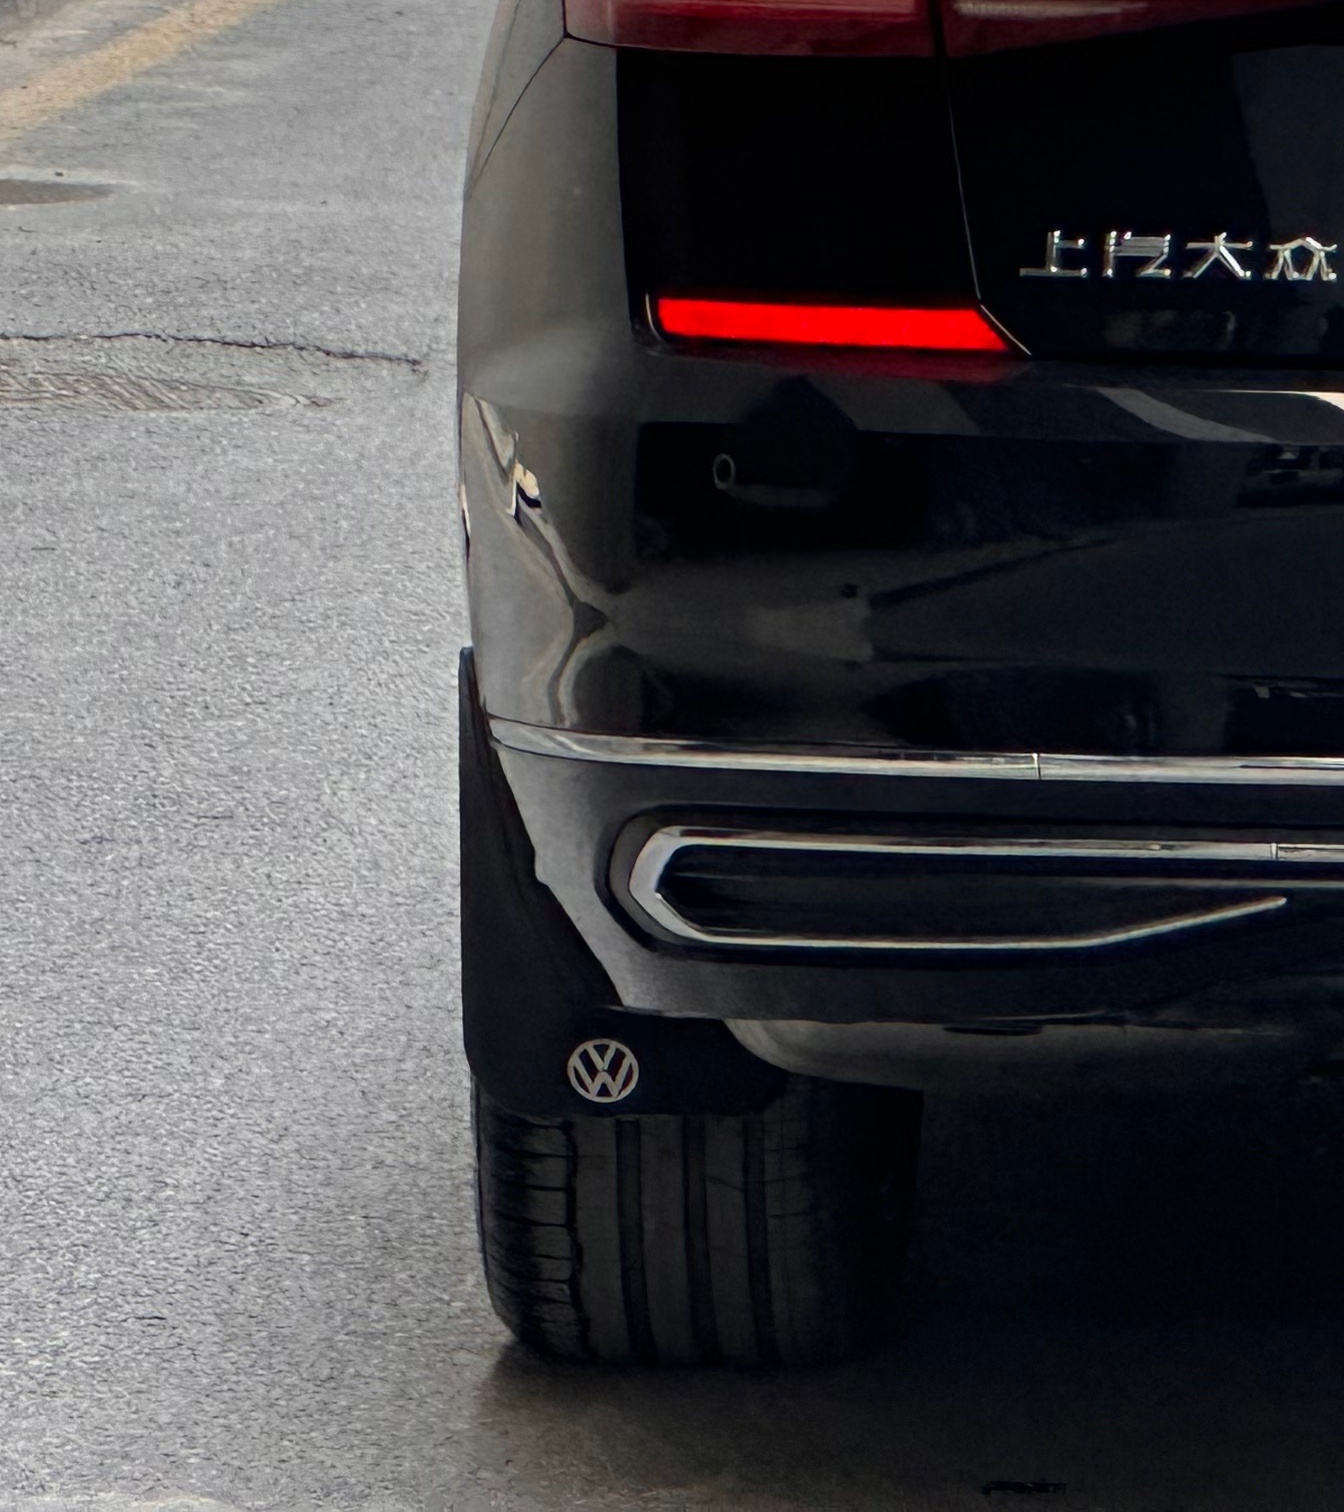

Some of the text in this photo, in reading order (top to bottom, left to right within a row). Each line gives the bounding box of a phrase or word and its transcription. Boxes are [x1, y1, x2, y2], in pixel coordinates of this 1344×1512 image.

[1018, 230, 1338, 281] 上汽大众
[567, 1039, 639, 1103] VW
